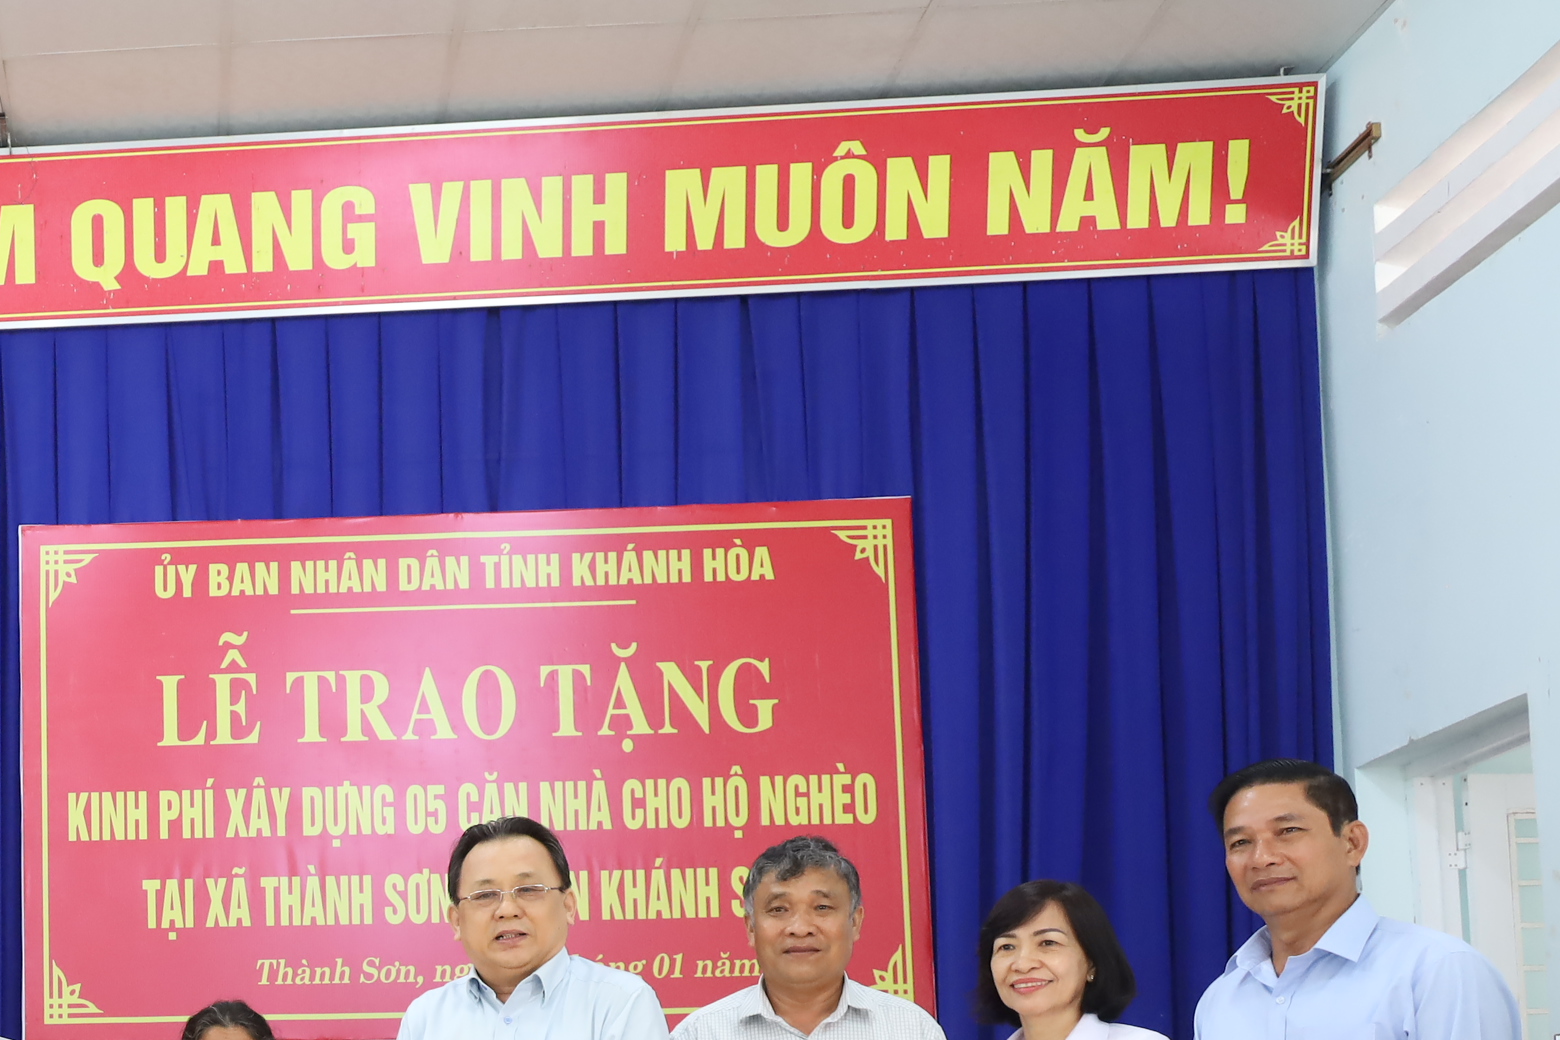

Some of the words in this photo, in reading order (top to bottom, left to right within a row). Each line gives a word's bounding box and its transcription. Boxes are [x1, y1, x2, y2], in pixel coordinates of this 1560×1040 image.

[71, 186, 376, 290] QUANG
[410, 172, 627, 263] VINH
[665, 141, 950, 251] MUÔN
[987, 127, 1249, 235] NĂM!
[156, 554, 197, 598] ỦY
[209, 562, 279, 596] BAN
[291, 552, 387, 593] NHÂN
[400, 550, 469, 590] DÂN
[482, 544, 560, 587] TỈNH
[573, 544, 691, 585] KHÁNH
[704, 539, 774, 581] HÒA
[157, 632, 261, 746] LỄ
[287, 666, 516, 742] TRAO
[542, 643, 779, 752] TẶNG
[69, 791, 148, 841] KINH
[160, 779, 215, 839] PHÍ
[227, 777, 291, 837] XÂY
[304, 781, 394, 846] DỰNG
[408, 785, 446, 833] 05
[458, 771, 528, 831] CĂN
[541, 769, 612, 830] NHÀ
[623, 778, 691, 829] CHO
[703, 765, 748, 838] HỘ
[760, 763, 877, 825] NGHÈO
[143, 879, 194, 939] TẠI
[206, 868, 251, 927] XÃ
[261, 866, 373, 926] THÀNH
[384, 868, 449, 925] SƠN
[601, 858, 719, 920] KHÁNH
[257, 958, 351, 985] Thành
[360, 957, 425, 986] Sơn,
[653, 953, 684, 979] 01
[693, 951, 761, 978] năm
